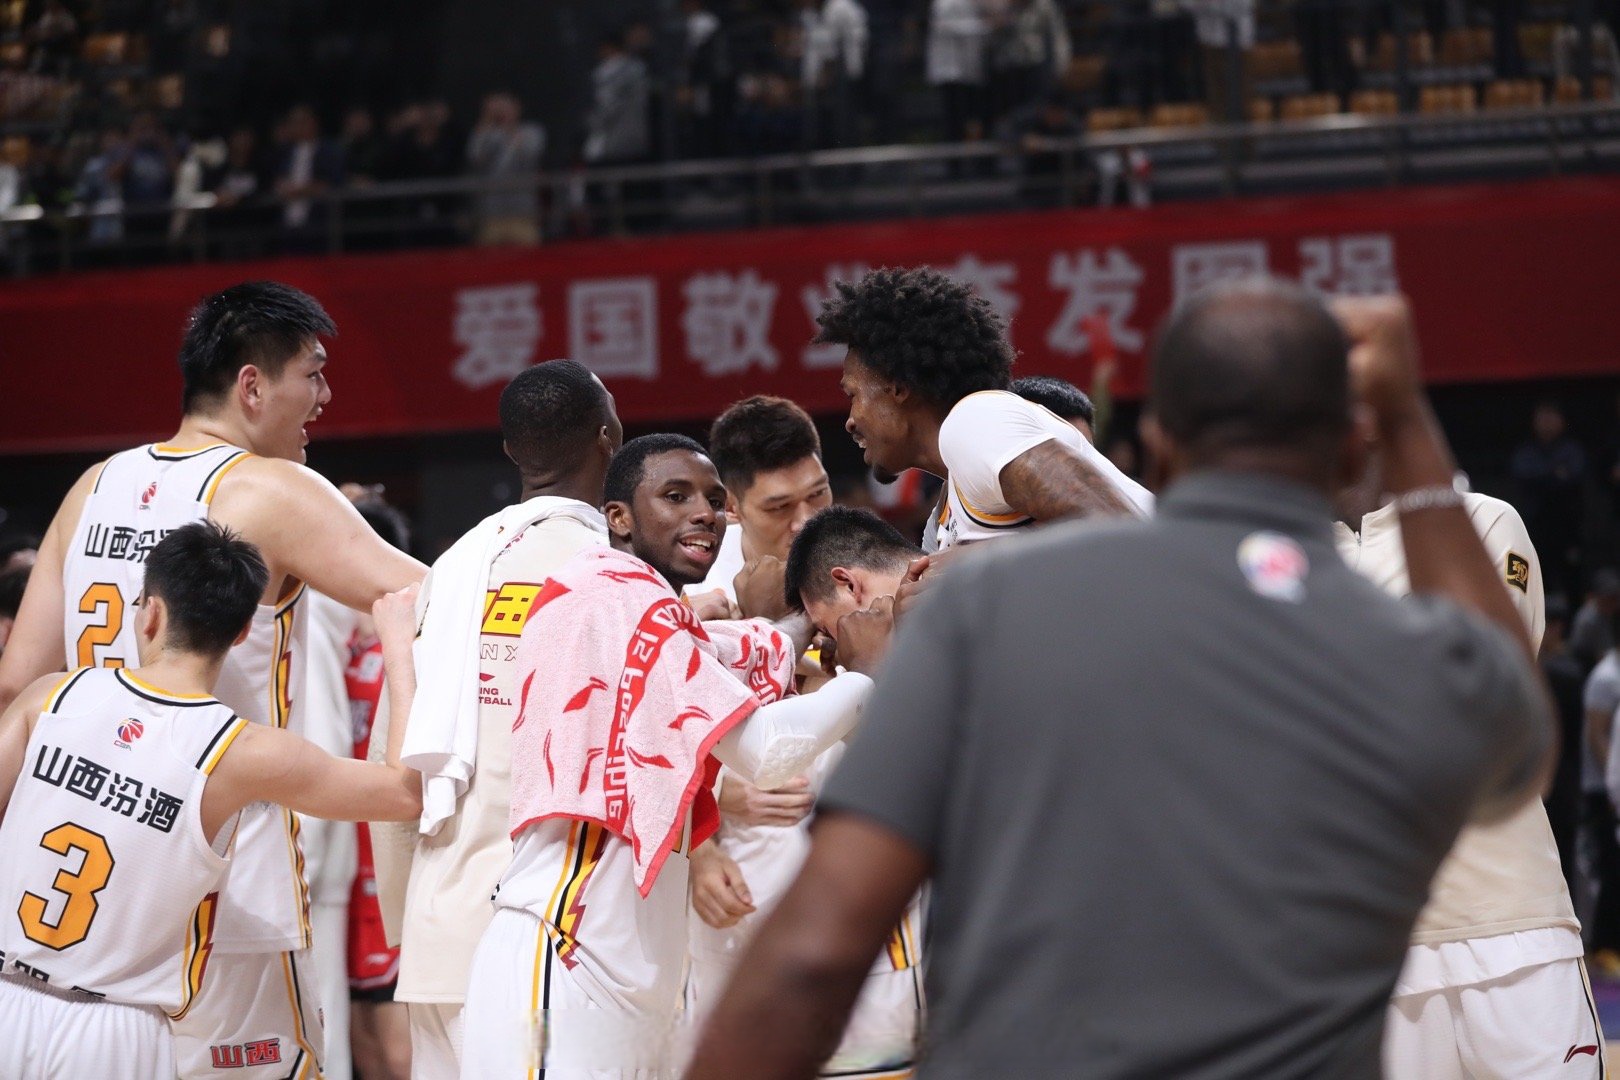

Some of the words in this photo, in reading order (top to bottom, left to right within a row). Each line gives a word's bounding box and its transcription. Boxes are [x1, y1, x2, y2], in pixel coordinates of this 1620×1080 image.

[84, 523, 180, 563] 山西汾
[480, 582, 544, 638] 西
[480, 643, 498, 661] N
[478, 697, 513, 706] TBALL
[479, 687, 499, 696] ING
[32, 745, 184, 833] 山西汾酒
[18, 821, 115, 951] 3
[210, 1038, 281, 1068] 山西
